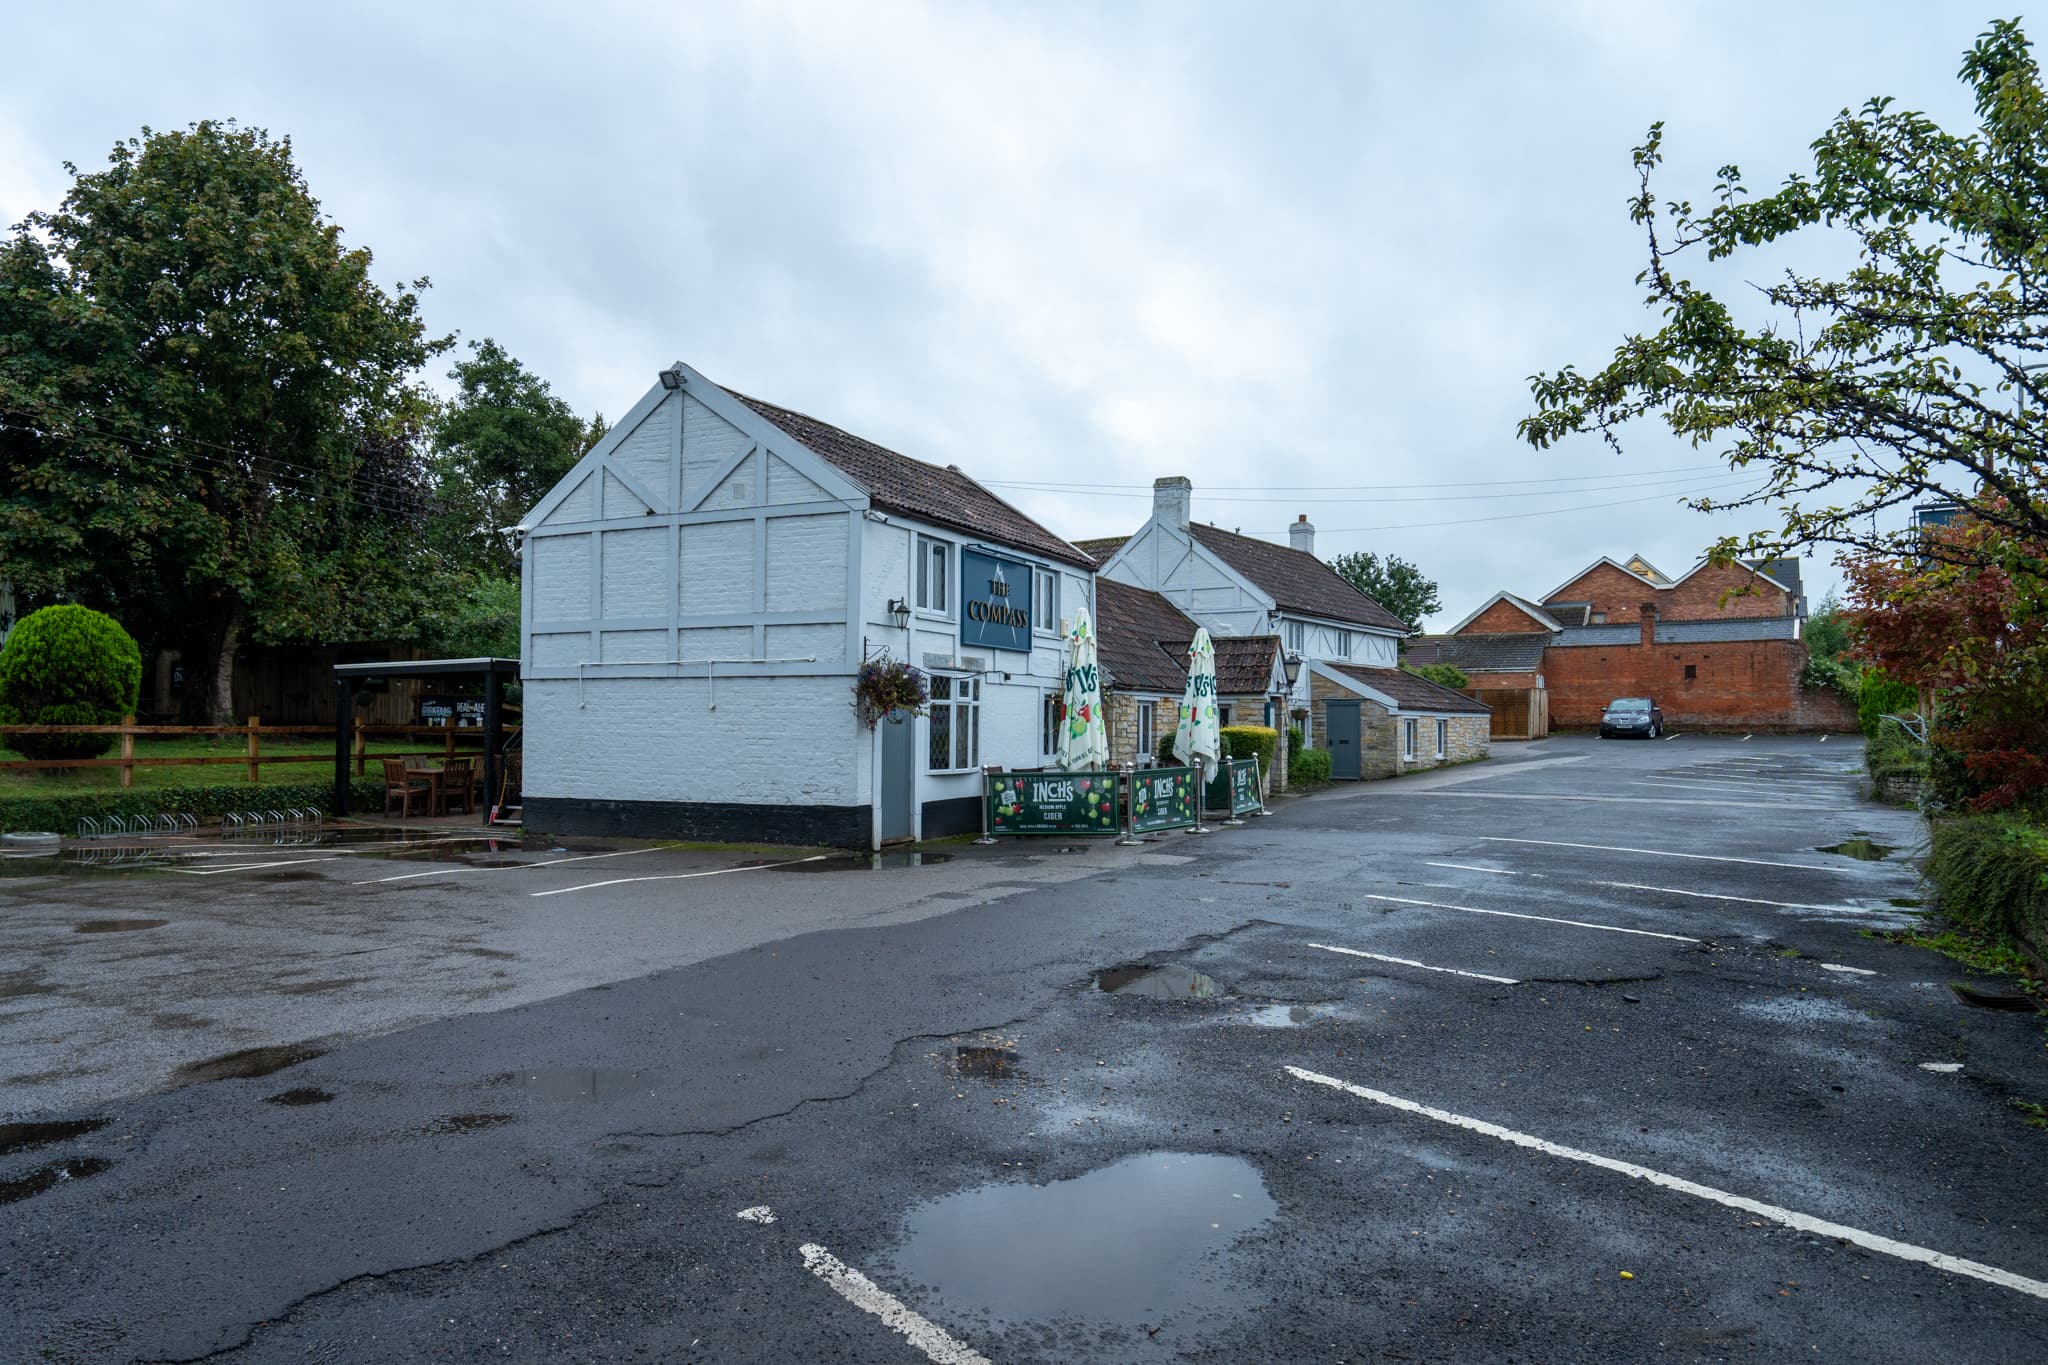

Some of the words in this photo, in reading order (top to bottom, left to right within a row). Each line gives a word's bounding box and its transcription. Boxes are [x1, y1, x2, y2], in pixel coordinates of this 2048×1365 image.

[991, 580, 1010, 597] THE
[969, 600, 1028, 627] COMPASS
[1043, 812, 1063, 821] CIDER
